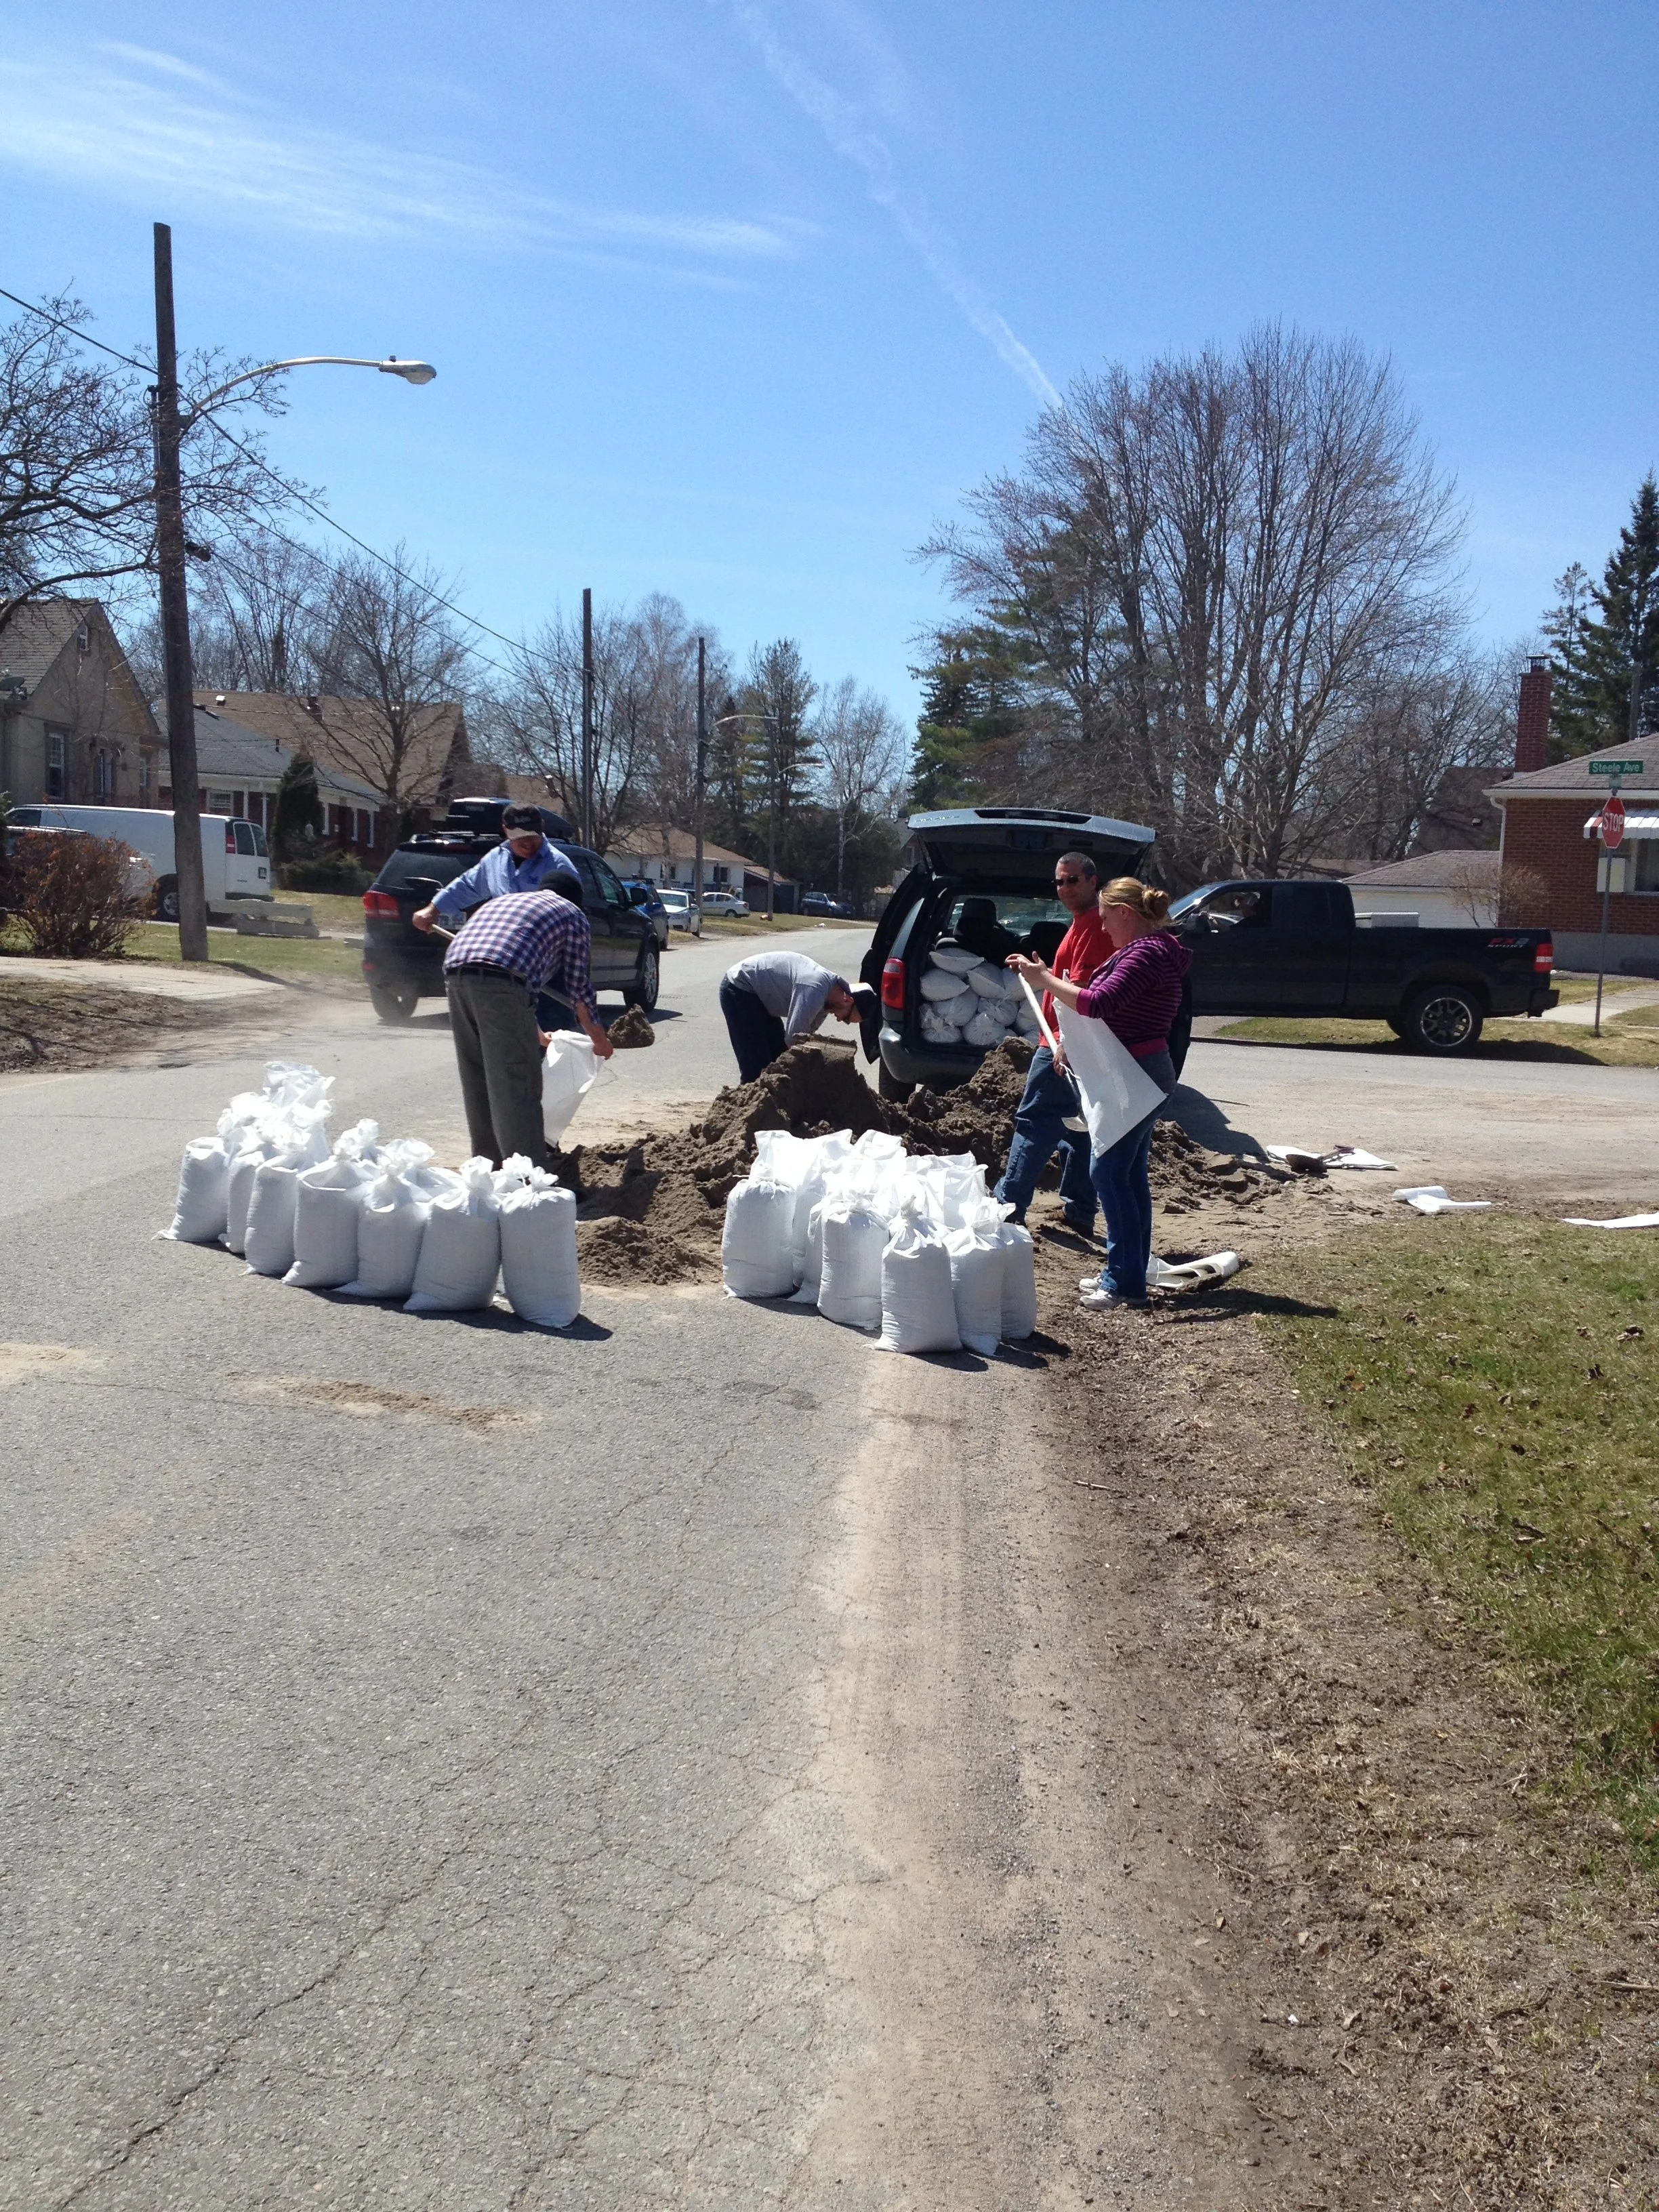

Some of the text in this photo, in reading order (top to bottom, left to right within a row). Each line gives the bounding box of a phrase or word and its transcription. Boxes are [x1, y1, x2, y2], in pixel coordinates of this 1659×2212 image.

[1592, 762, 1640, 773] Steele Ave
[1603, 812, 1624, 832] STOP
